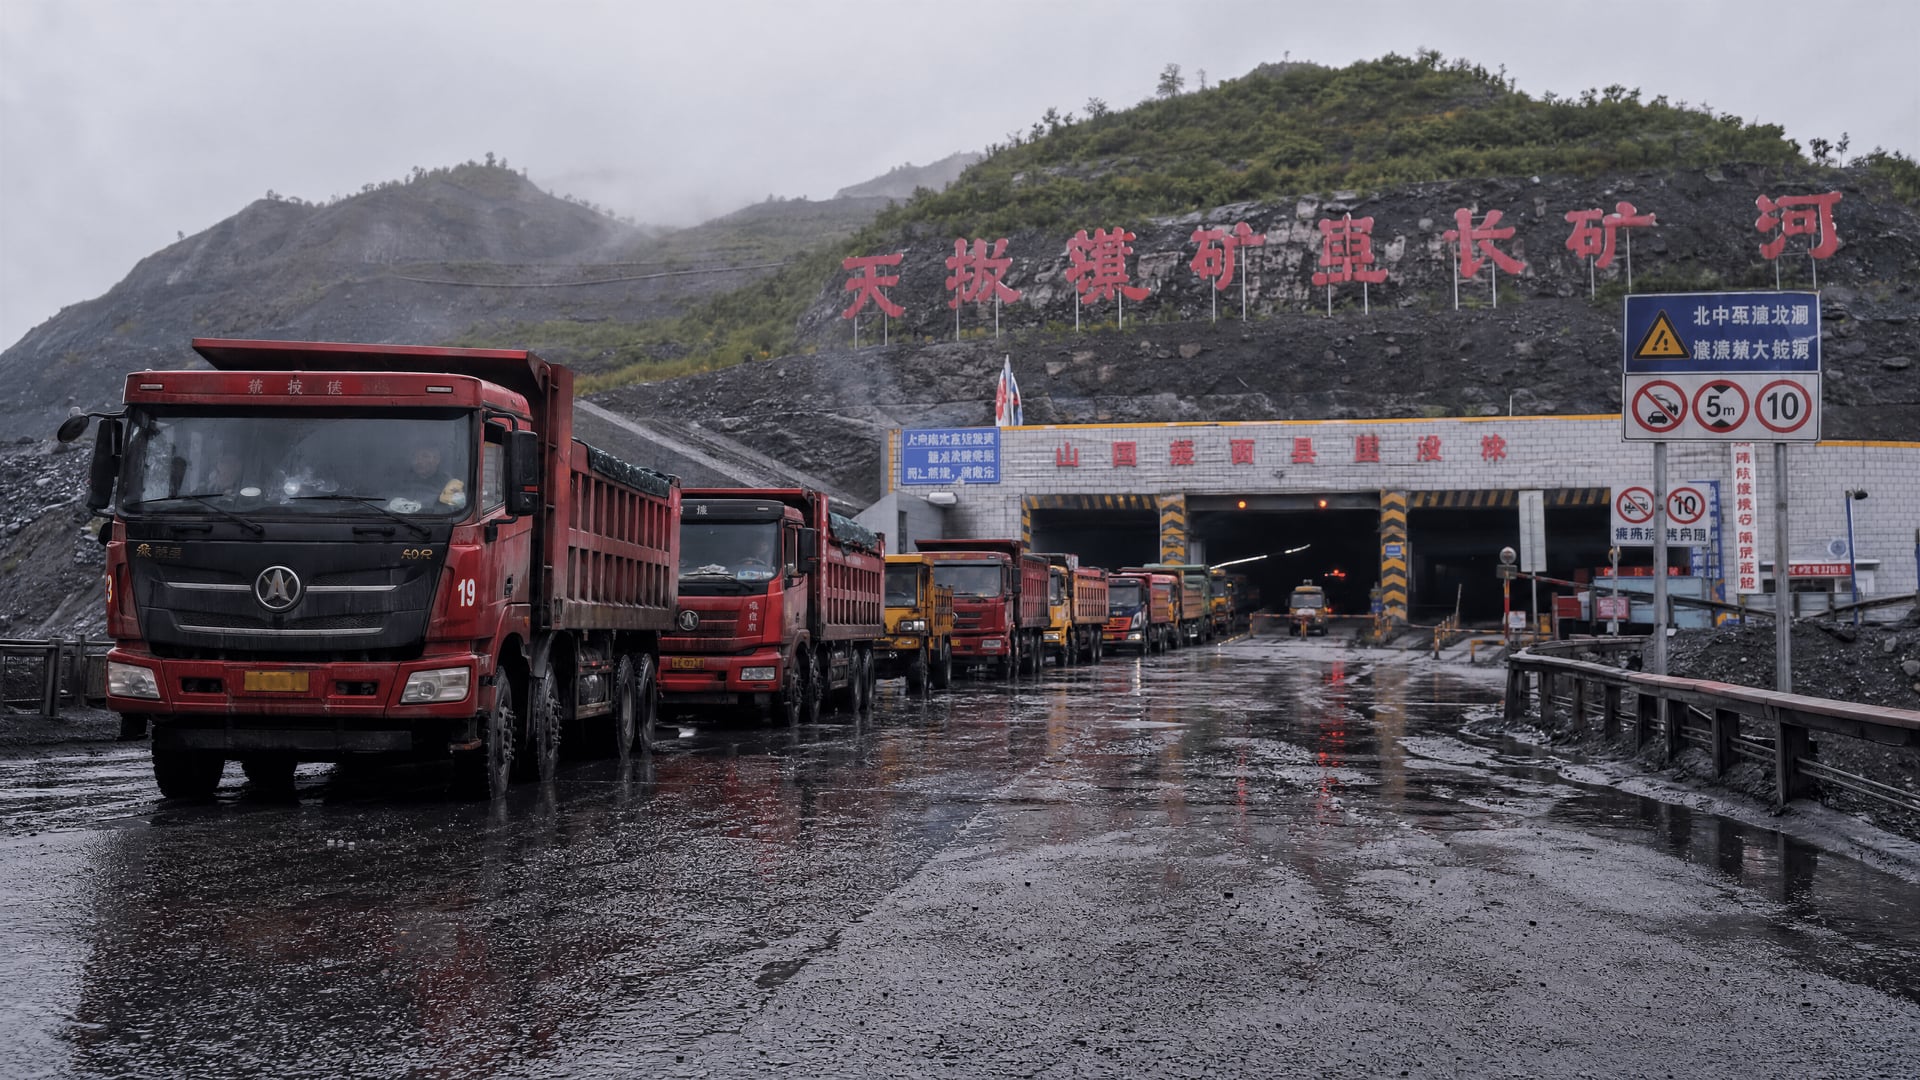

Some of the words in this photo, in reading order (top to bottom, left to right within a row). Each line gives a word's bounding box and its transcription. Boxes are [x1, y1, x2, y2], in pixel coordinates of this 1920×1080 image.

[1707, 395, 1735, 417] 5m
[1767, 392, 1798, 420] 10
[1674, 496, 1696, 515] 10
[457, 578, 476, 607] 19
